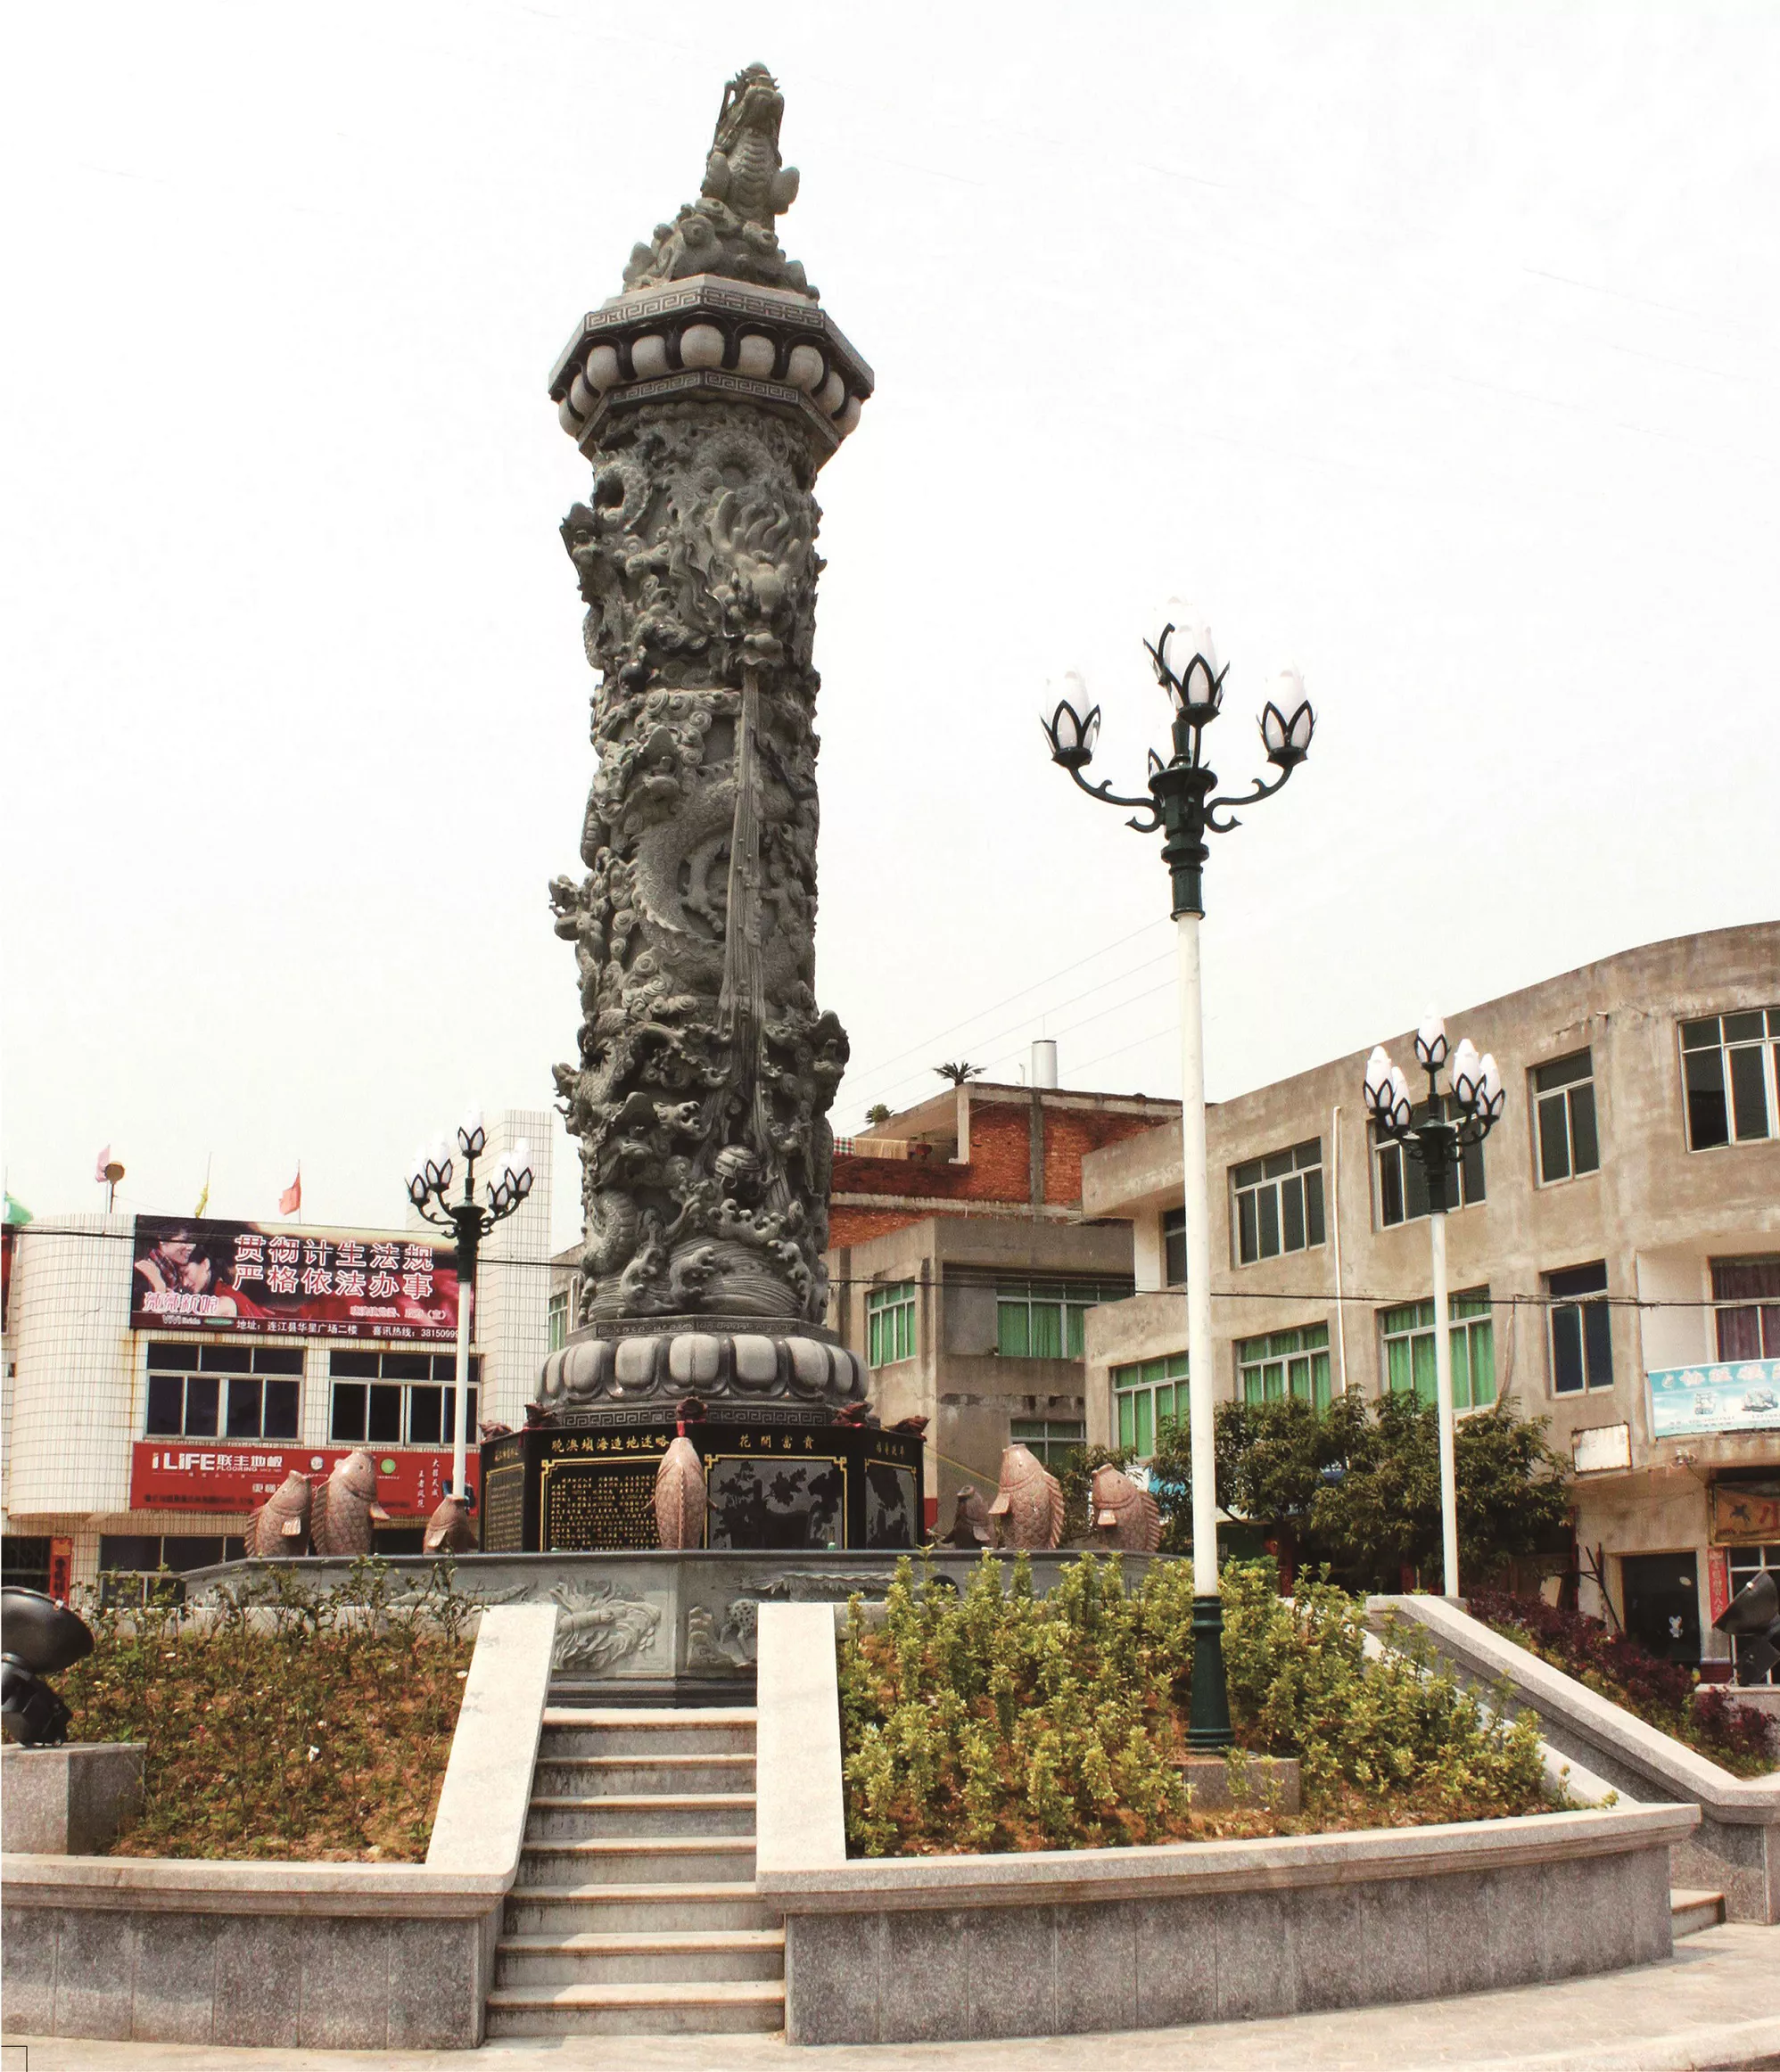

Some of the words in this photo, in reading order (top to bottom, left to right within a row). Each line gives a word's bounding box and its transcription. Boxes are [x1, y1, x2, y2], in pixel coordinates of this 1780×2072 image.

[234, 1234, 434, 1271] 贯彻计生法规
[232, 1264, 433, 1300] 严格依法办事
